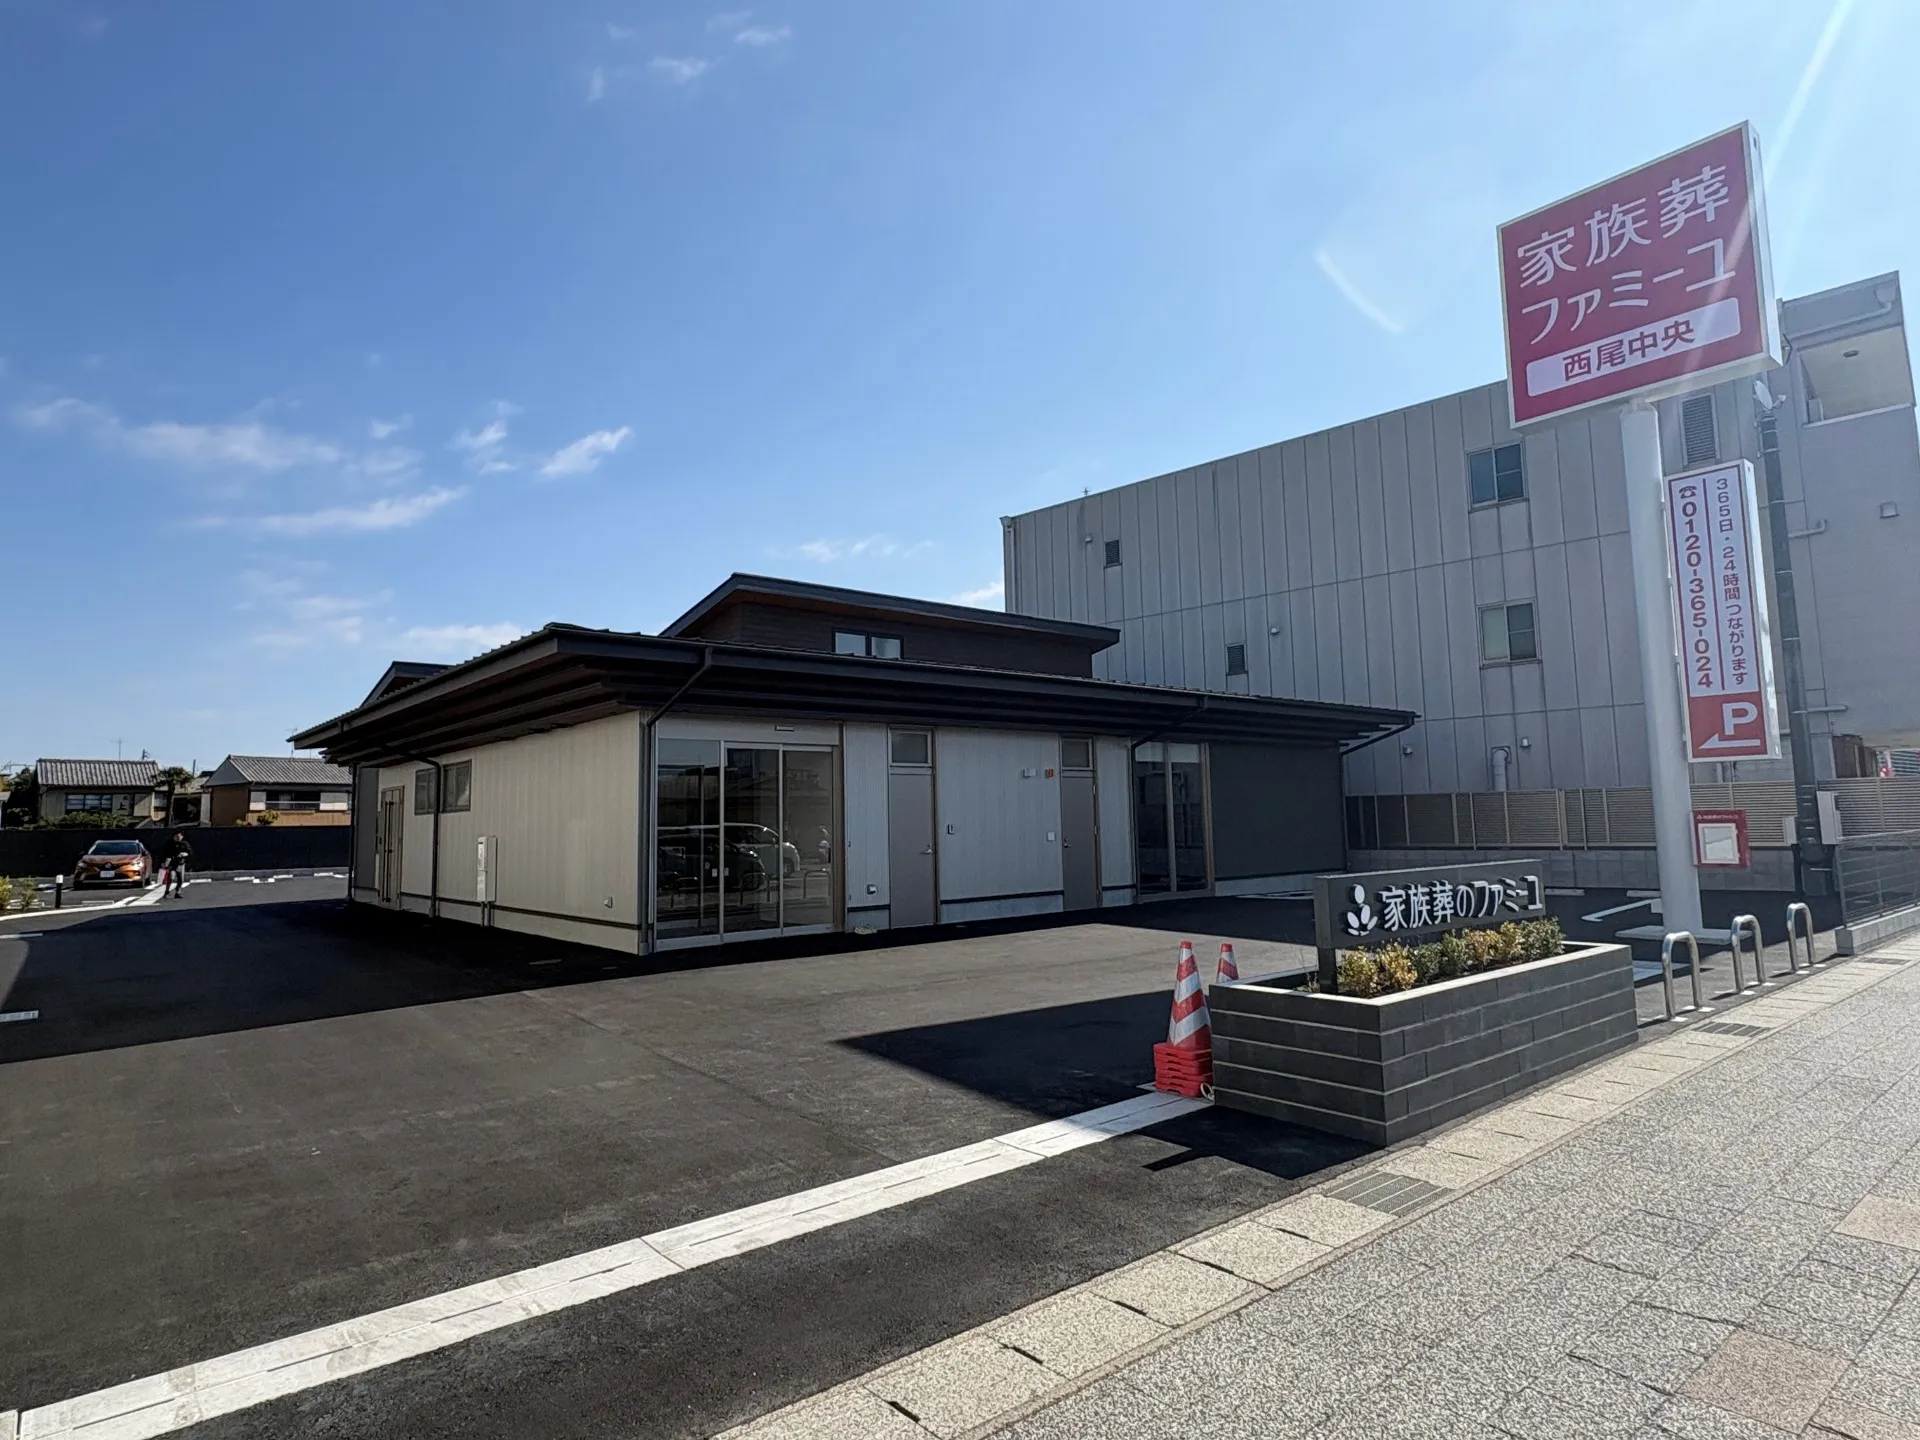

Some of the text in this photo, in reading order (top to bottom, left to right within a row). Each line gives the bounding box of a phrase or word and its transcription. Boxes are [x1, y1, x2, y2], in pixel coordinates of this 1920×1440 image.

[1517, 165, 1729, 288] 家族葬
[1522, 238, 1736, 345] ファミーユ
[1563, 320, 1695, 381] 西尾中央
[1722, 702, 1758, 735] P
